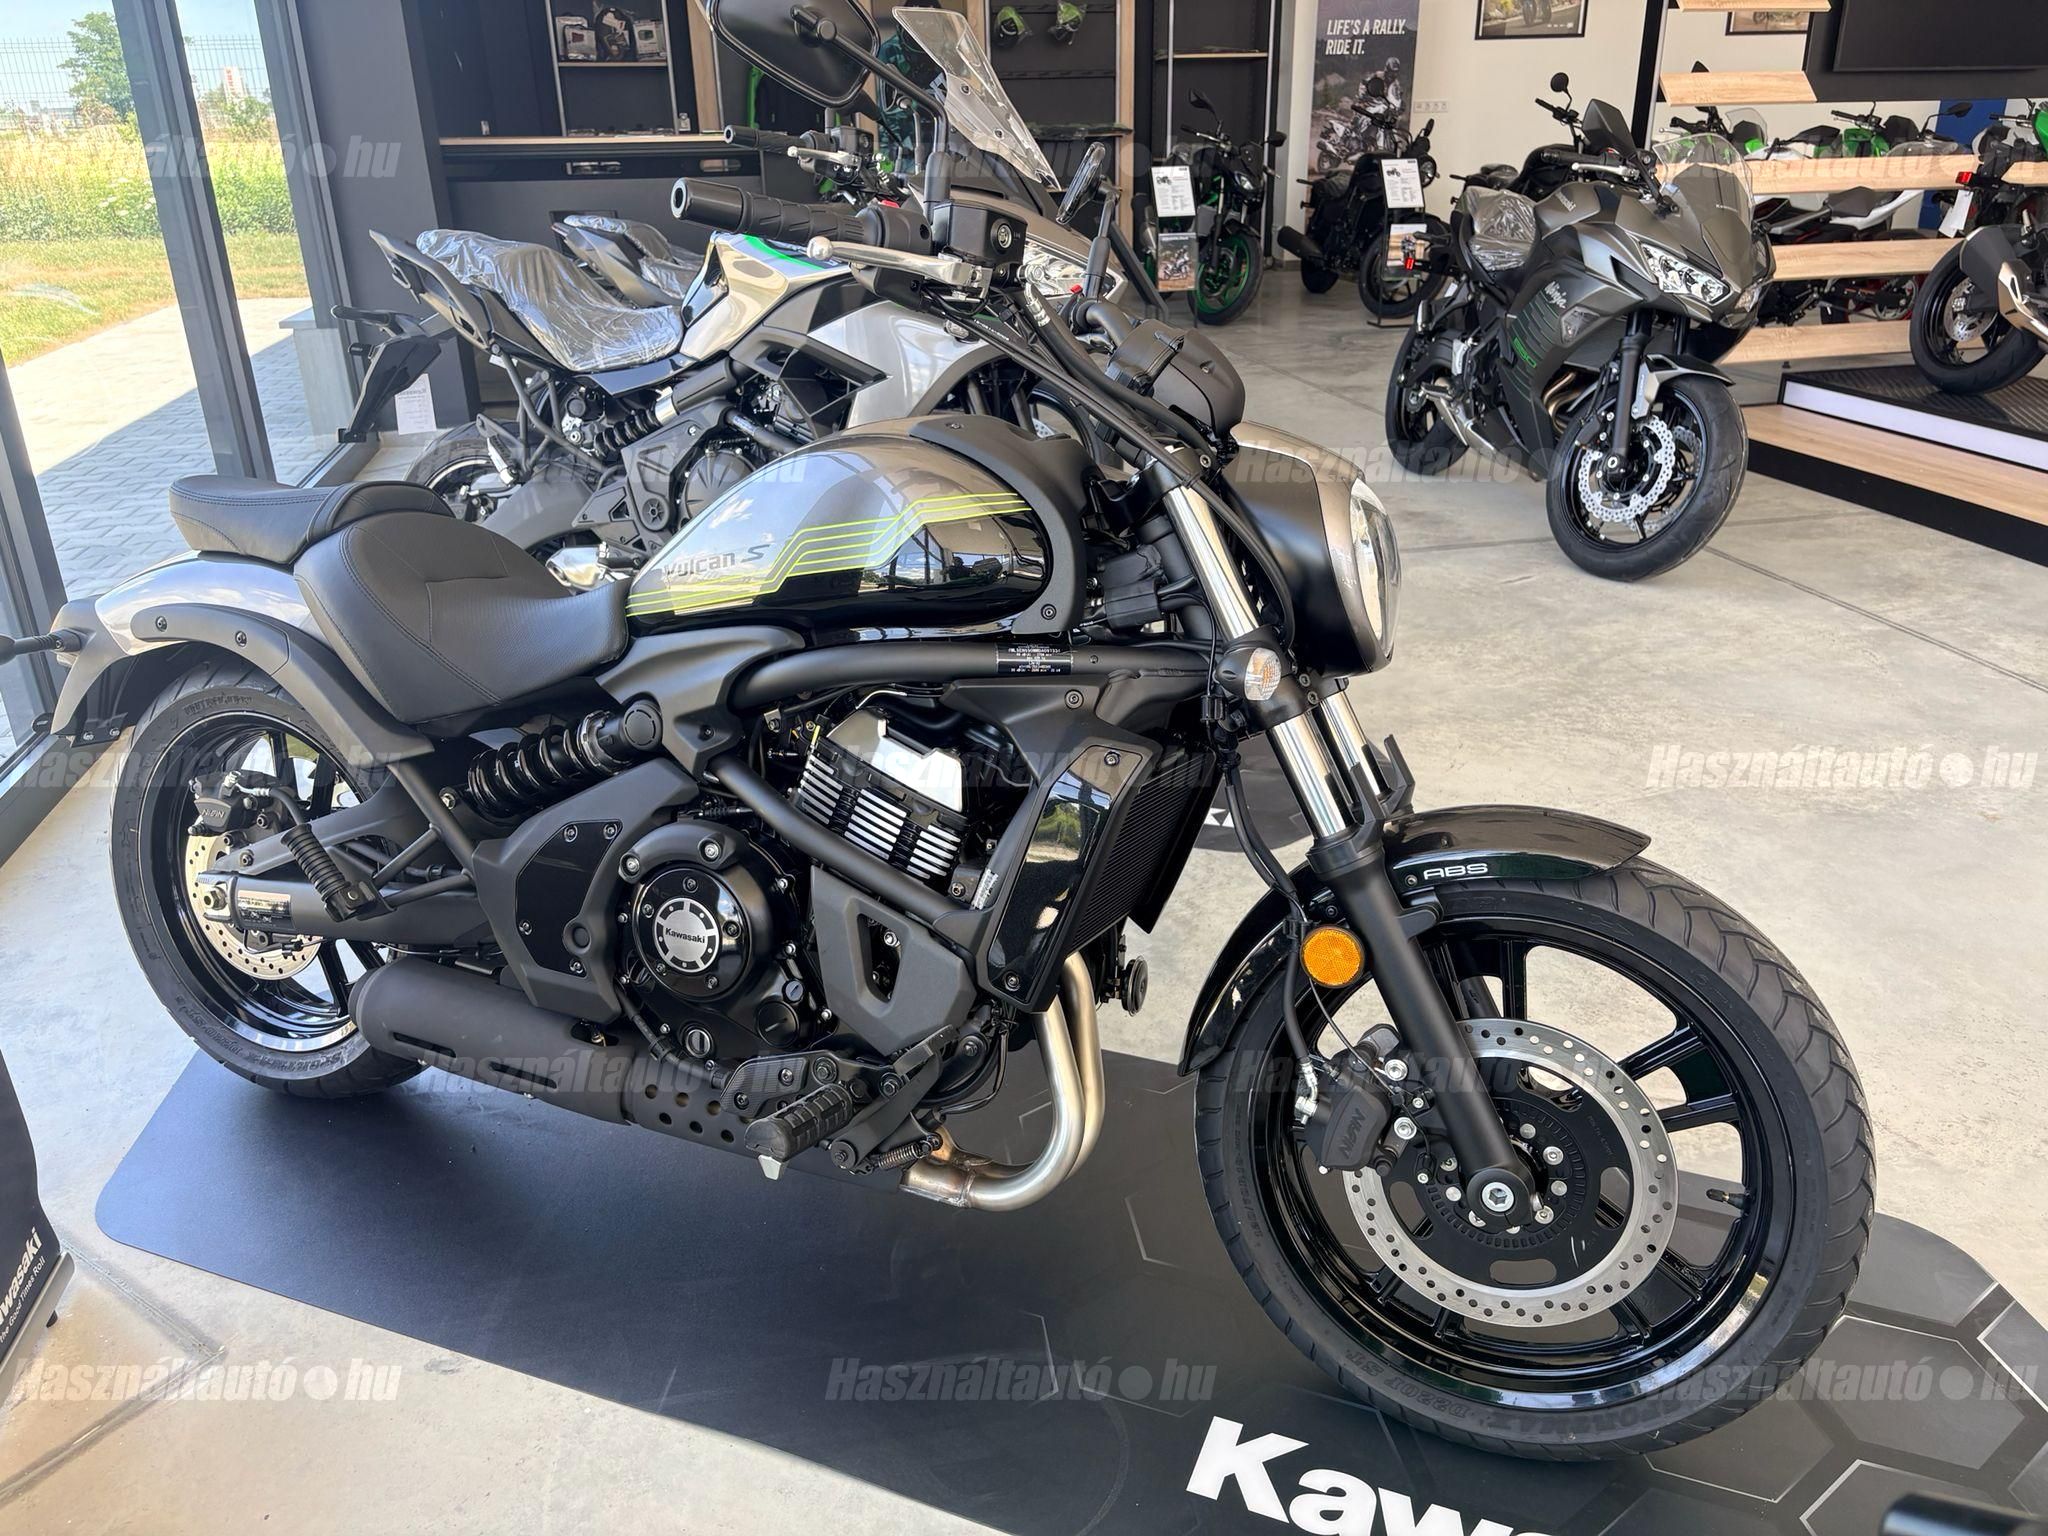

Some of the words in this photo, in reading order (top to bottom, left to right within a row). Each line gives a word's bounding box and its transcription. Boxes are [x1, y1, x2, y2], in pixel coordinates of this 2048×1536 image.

[1326, 19, 1361, 35] LIFE'S
[1362, 20, 1370, 35] A
[1372, 19, 1406, 35] RALLY.
[1325, 40, 1350, 55] RIDE
[1352, 39, 1365, 55] IT.
[740, 544, 772, 563] S
[1423, 863, 1489, 880] ABS
[665, 928, 705, 943] Kawasaki
[9, 1298, 23, 1326] Good
[20, 1275, 35, 1301] Times
[32, 1255, 46, 1277] Roll
[1186, 1416, 1556, 1536] Kaw
